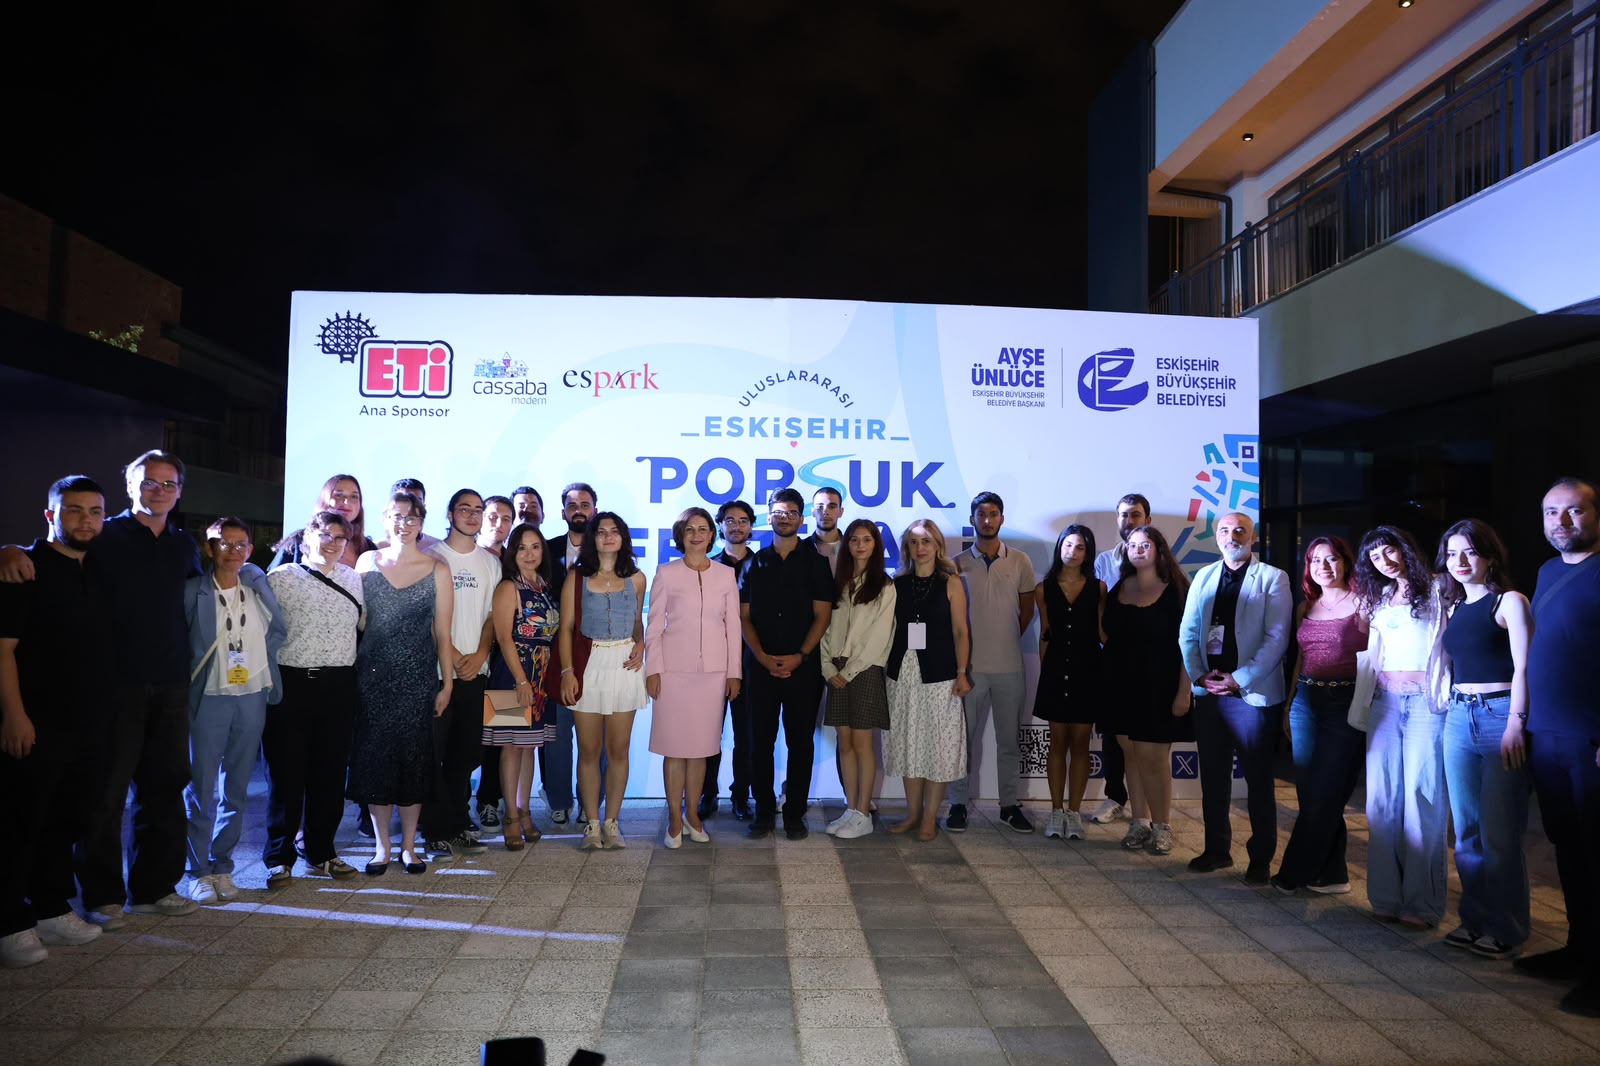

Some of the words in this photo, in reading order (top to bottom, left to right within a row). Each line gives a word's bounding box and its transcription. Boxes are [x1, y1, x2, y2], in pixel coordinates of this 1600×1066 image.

[997, 347, 1045, 368] AYŞE
[1156, 356, 1219, 372] ESKİŞEHİR
[562, 363, 660, 397] espark
[971, 363, 1045, 388] ÜNLÜCE
[1156, 373, 1236, 390] BÜYÜKŞEHİR
[473, 379, 547, 397] cassaba
[738, 369, 854, 408] ULUSLARARASI
[972, 389, 1004, 398] ESKİŞEHİR
[1005, 390, 1045, 399] BÜYÜKŞEHİR
[511, 396, 547, 405] modern
[987, 399, 1016, 407] BELEDİYE
[1017, 400, 1045, 408] BAŞKANI
[1157, 392, 1226, 407] BELEDİYESİ
[359, 404, 387, 417] Ana
[391, 404, 450, 418] Sponsor
